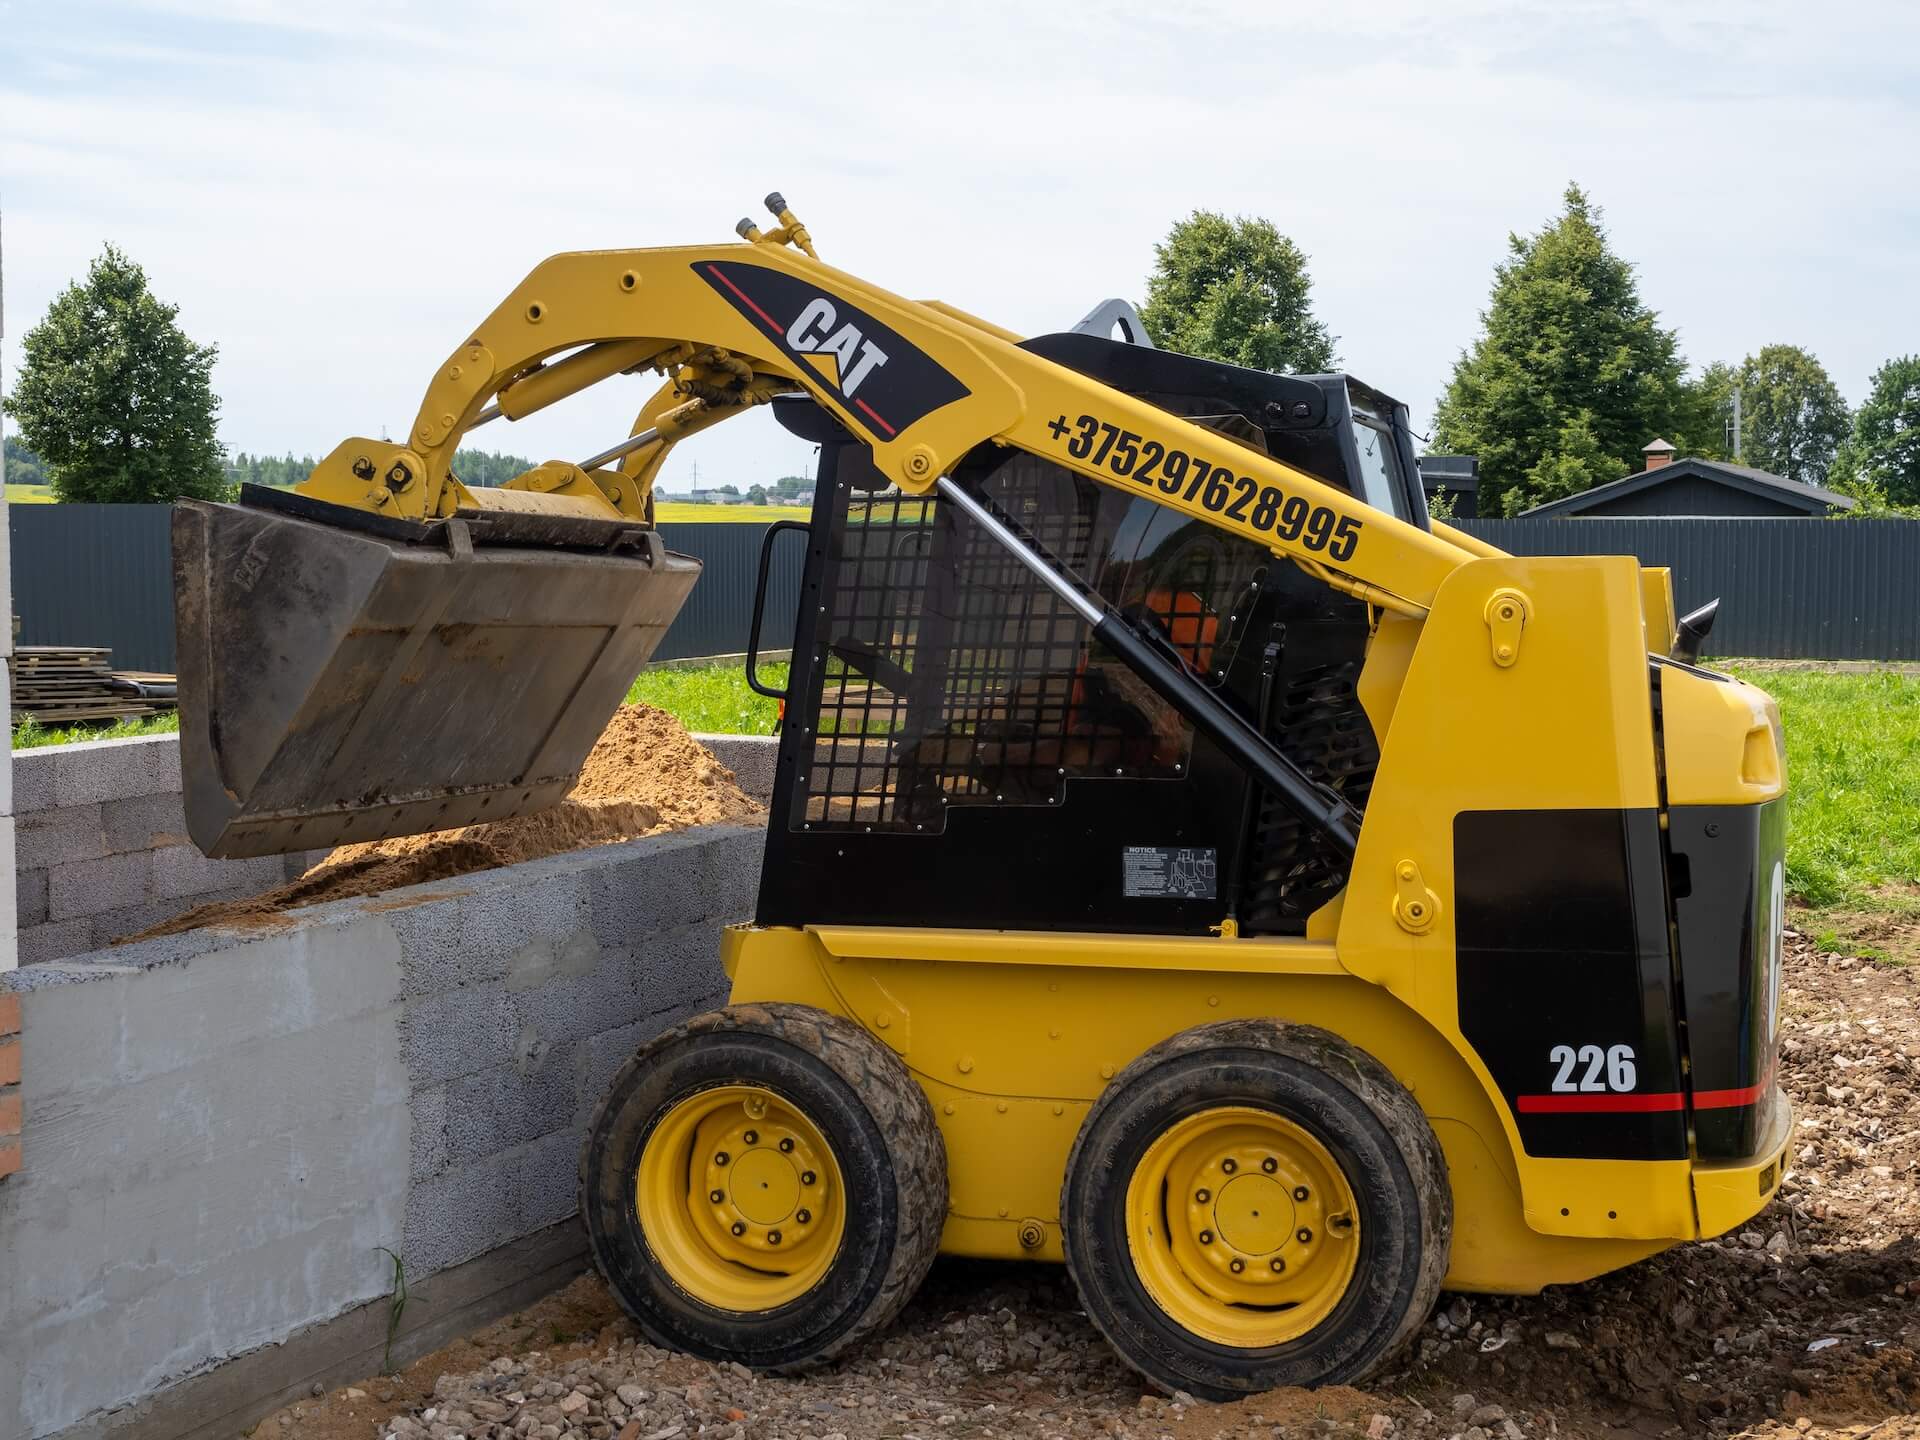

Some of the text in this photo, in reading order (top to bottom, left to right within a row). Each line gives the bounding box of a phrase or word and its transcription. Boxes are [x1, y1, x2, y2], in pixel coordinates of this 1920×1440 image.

[785, 297, 889, 399] CAT
[1047, 415, 1363, 562] +375297628995
[1549, 1044, 1637, 1093] 226
